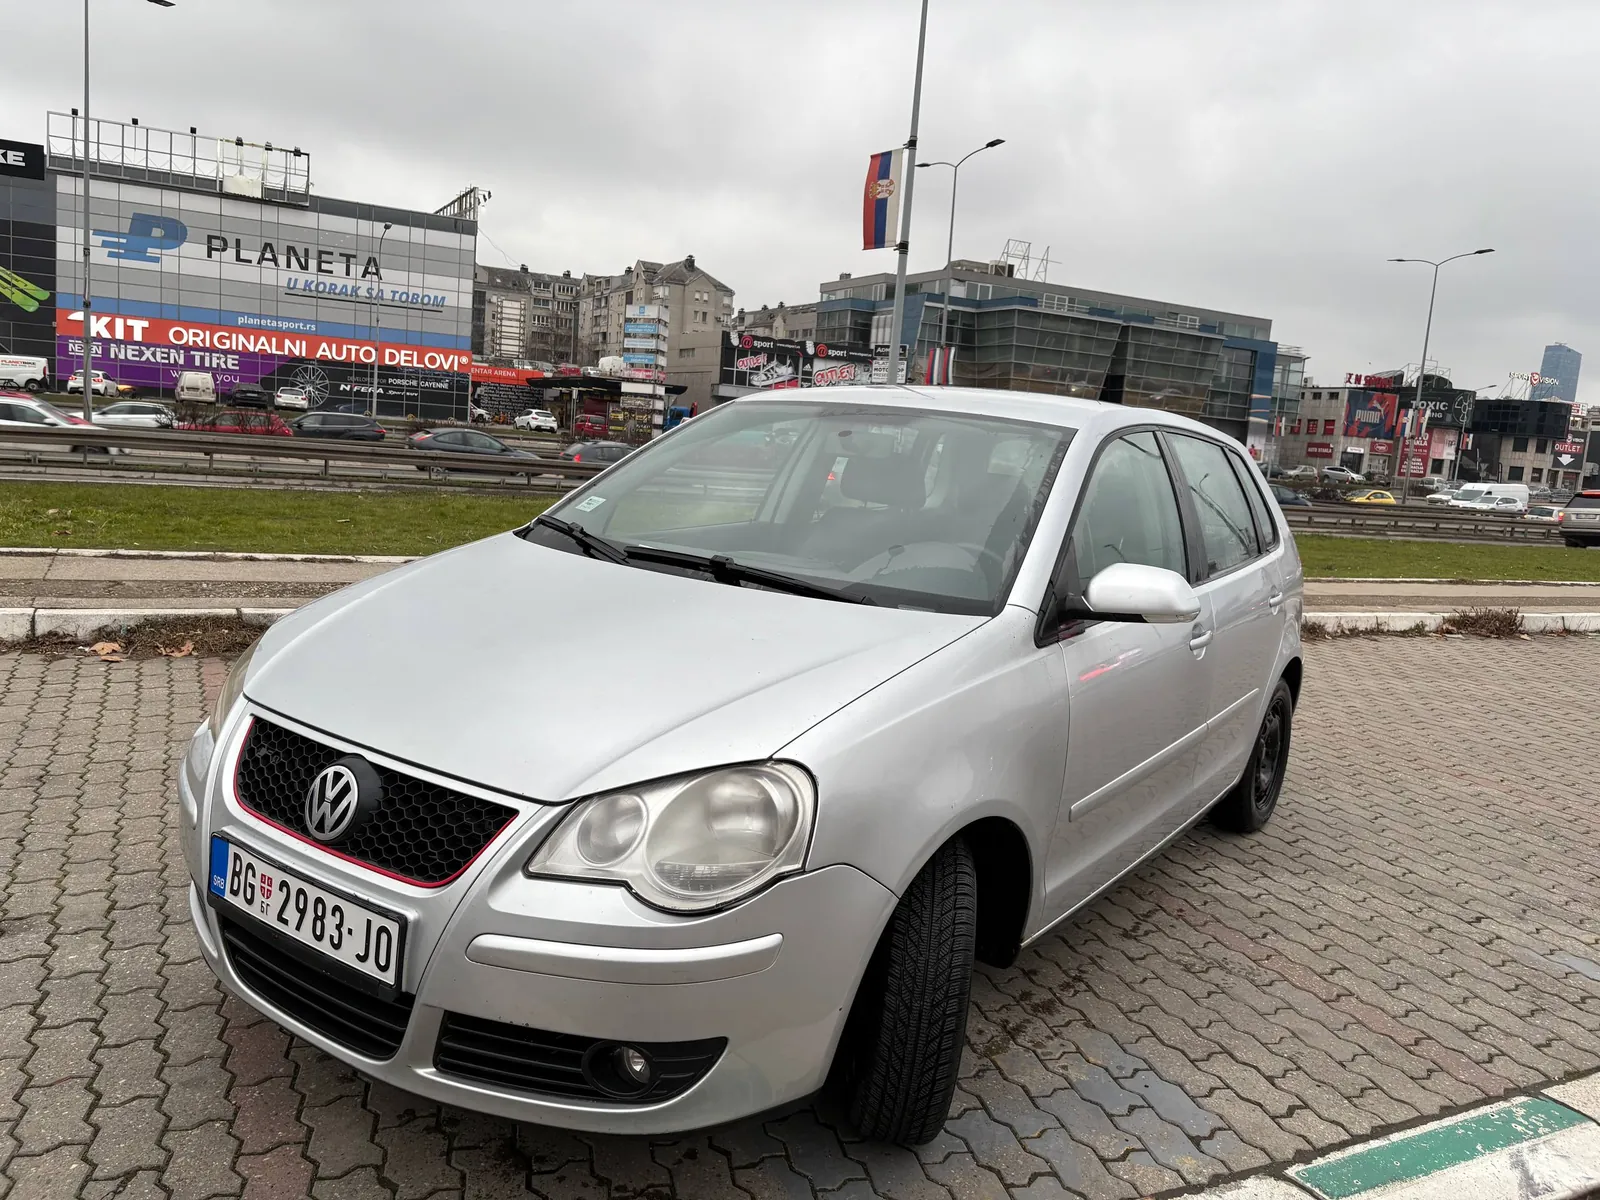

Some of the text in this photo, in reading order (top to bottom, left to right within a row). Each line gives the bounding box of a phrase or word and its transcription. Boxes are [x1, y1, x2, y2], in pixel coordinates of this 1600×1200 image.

[206, 234, 383, 281] PLANETA
[287, 277, 447, 308] U KORAK SA TOBOM
[238, 315, 317, 331] planetasport.rs
[168, 327, 307, 358] ORIGINALNI
[316, 342, 377, 363] AUTO
[110, 343, 240, 370] NEXEN TIRE
[216, 373, 240, 384] you
[471, 367, 493, 375] ENTAR
[494, 369, 516, 378] ARENA
[814, 363, 857, 386] OUTLET
[388, 378, 418, 387] PORSCHE
[420, 380, 449, 389] CAYENNE
[1540, 376, 1560, 386] VISION
[1410, 400, 1448, 411] TOXIC
[1355, 409, 1380, 424] PUMA
[1554, 443, 1581, 452] OUTLET
[213, 874, 225, 889] SRB
[229, 851, 257, 906] BG
